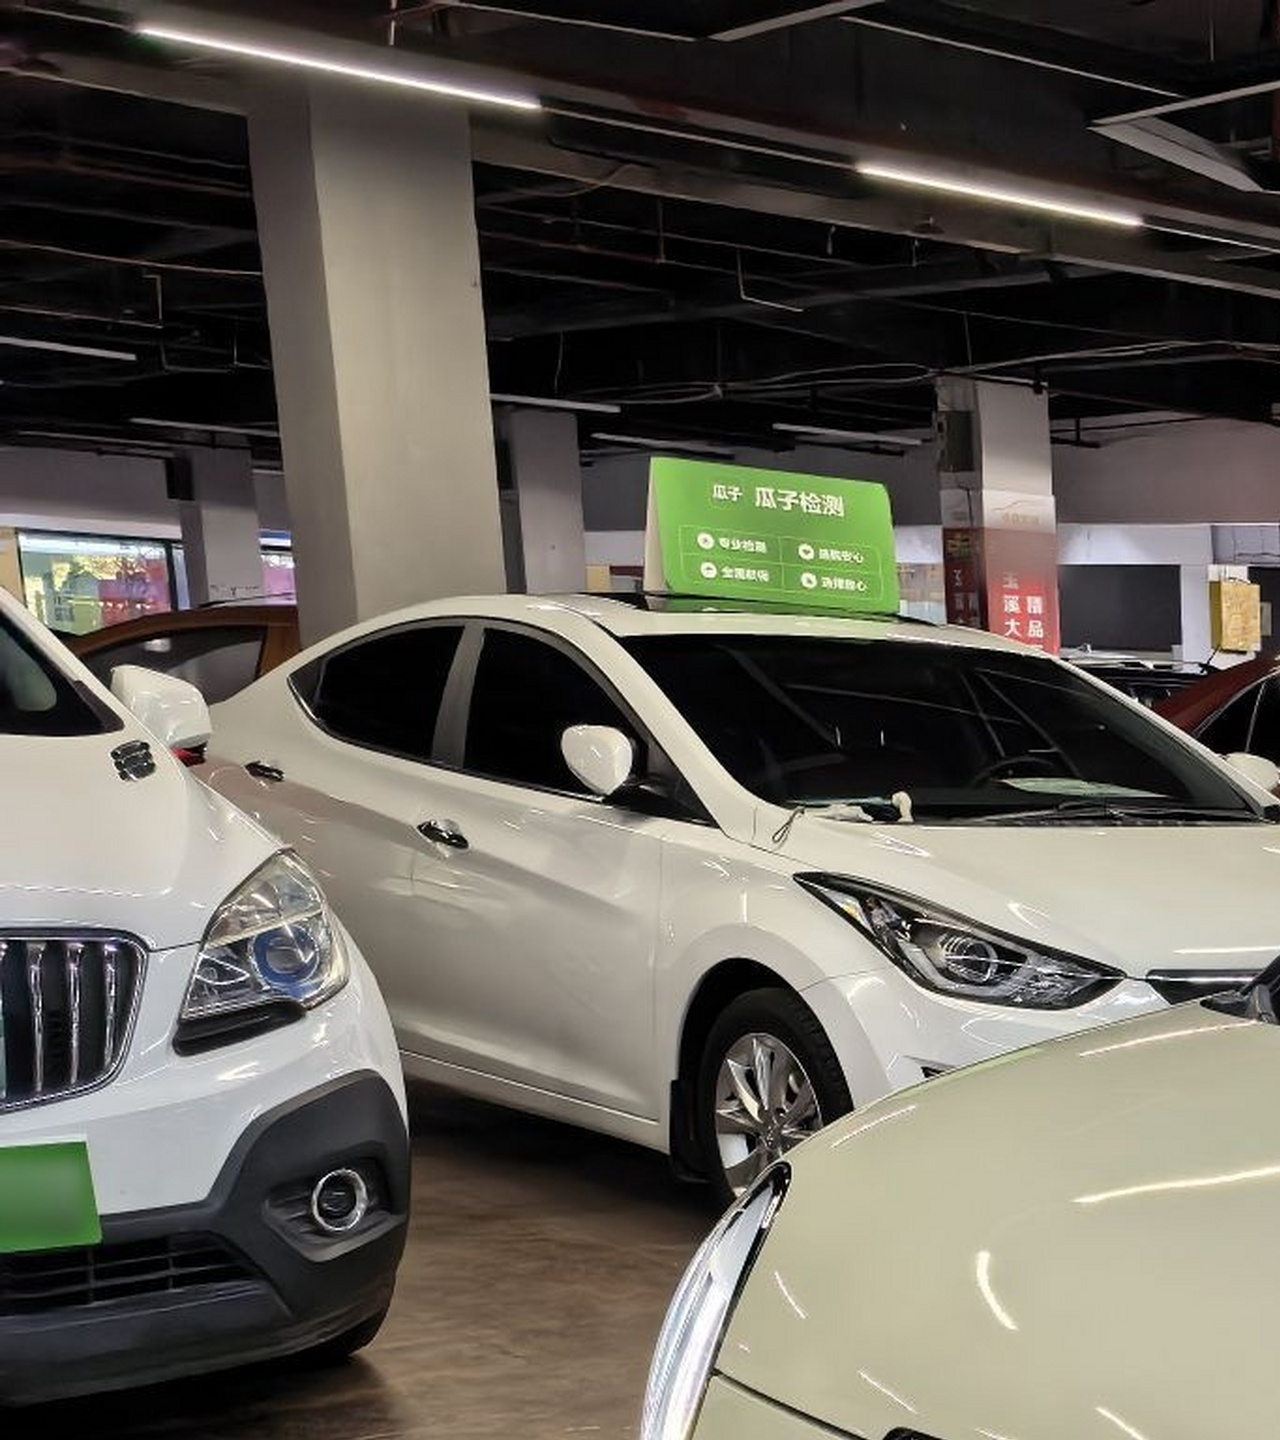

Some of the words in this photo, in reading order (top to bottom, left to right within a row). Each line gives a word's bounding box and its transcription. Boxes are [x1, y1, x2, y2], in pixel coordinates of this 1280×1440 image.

[712, 484, 743, 502] 瓜子
[755, 486, 845, 518] 瓜子检测
